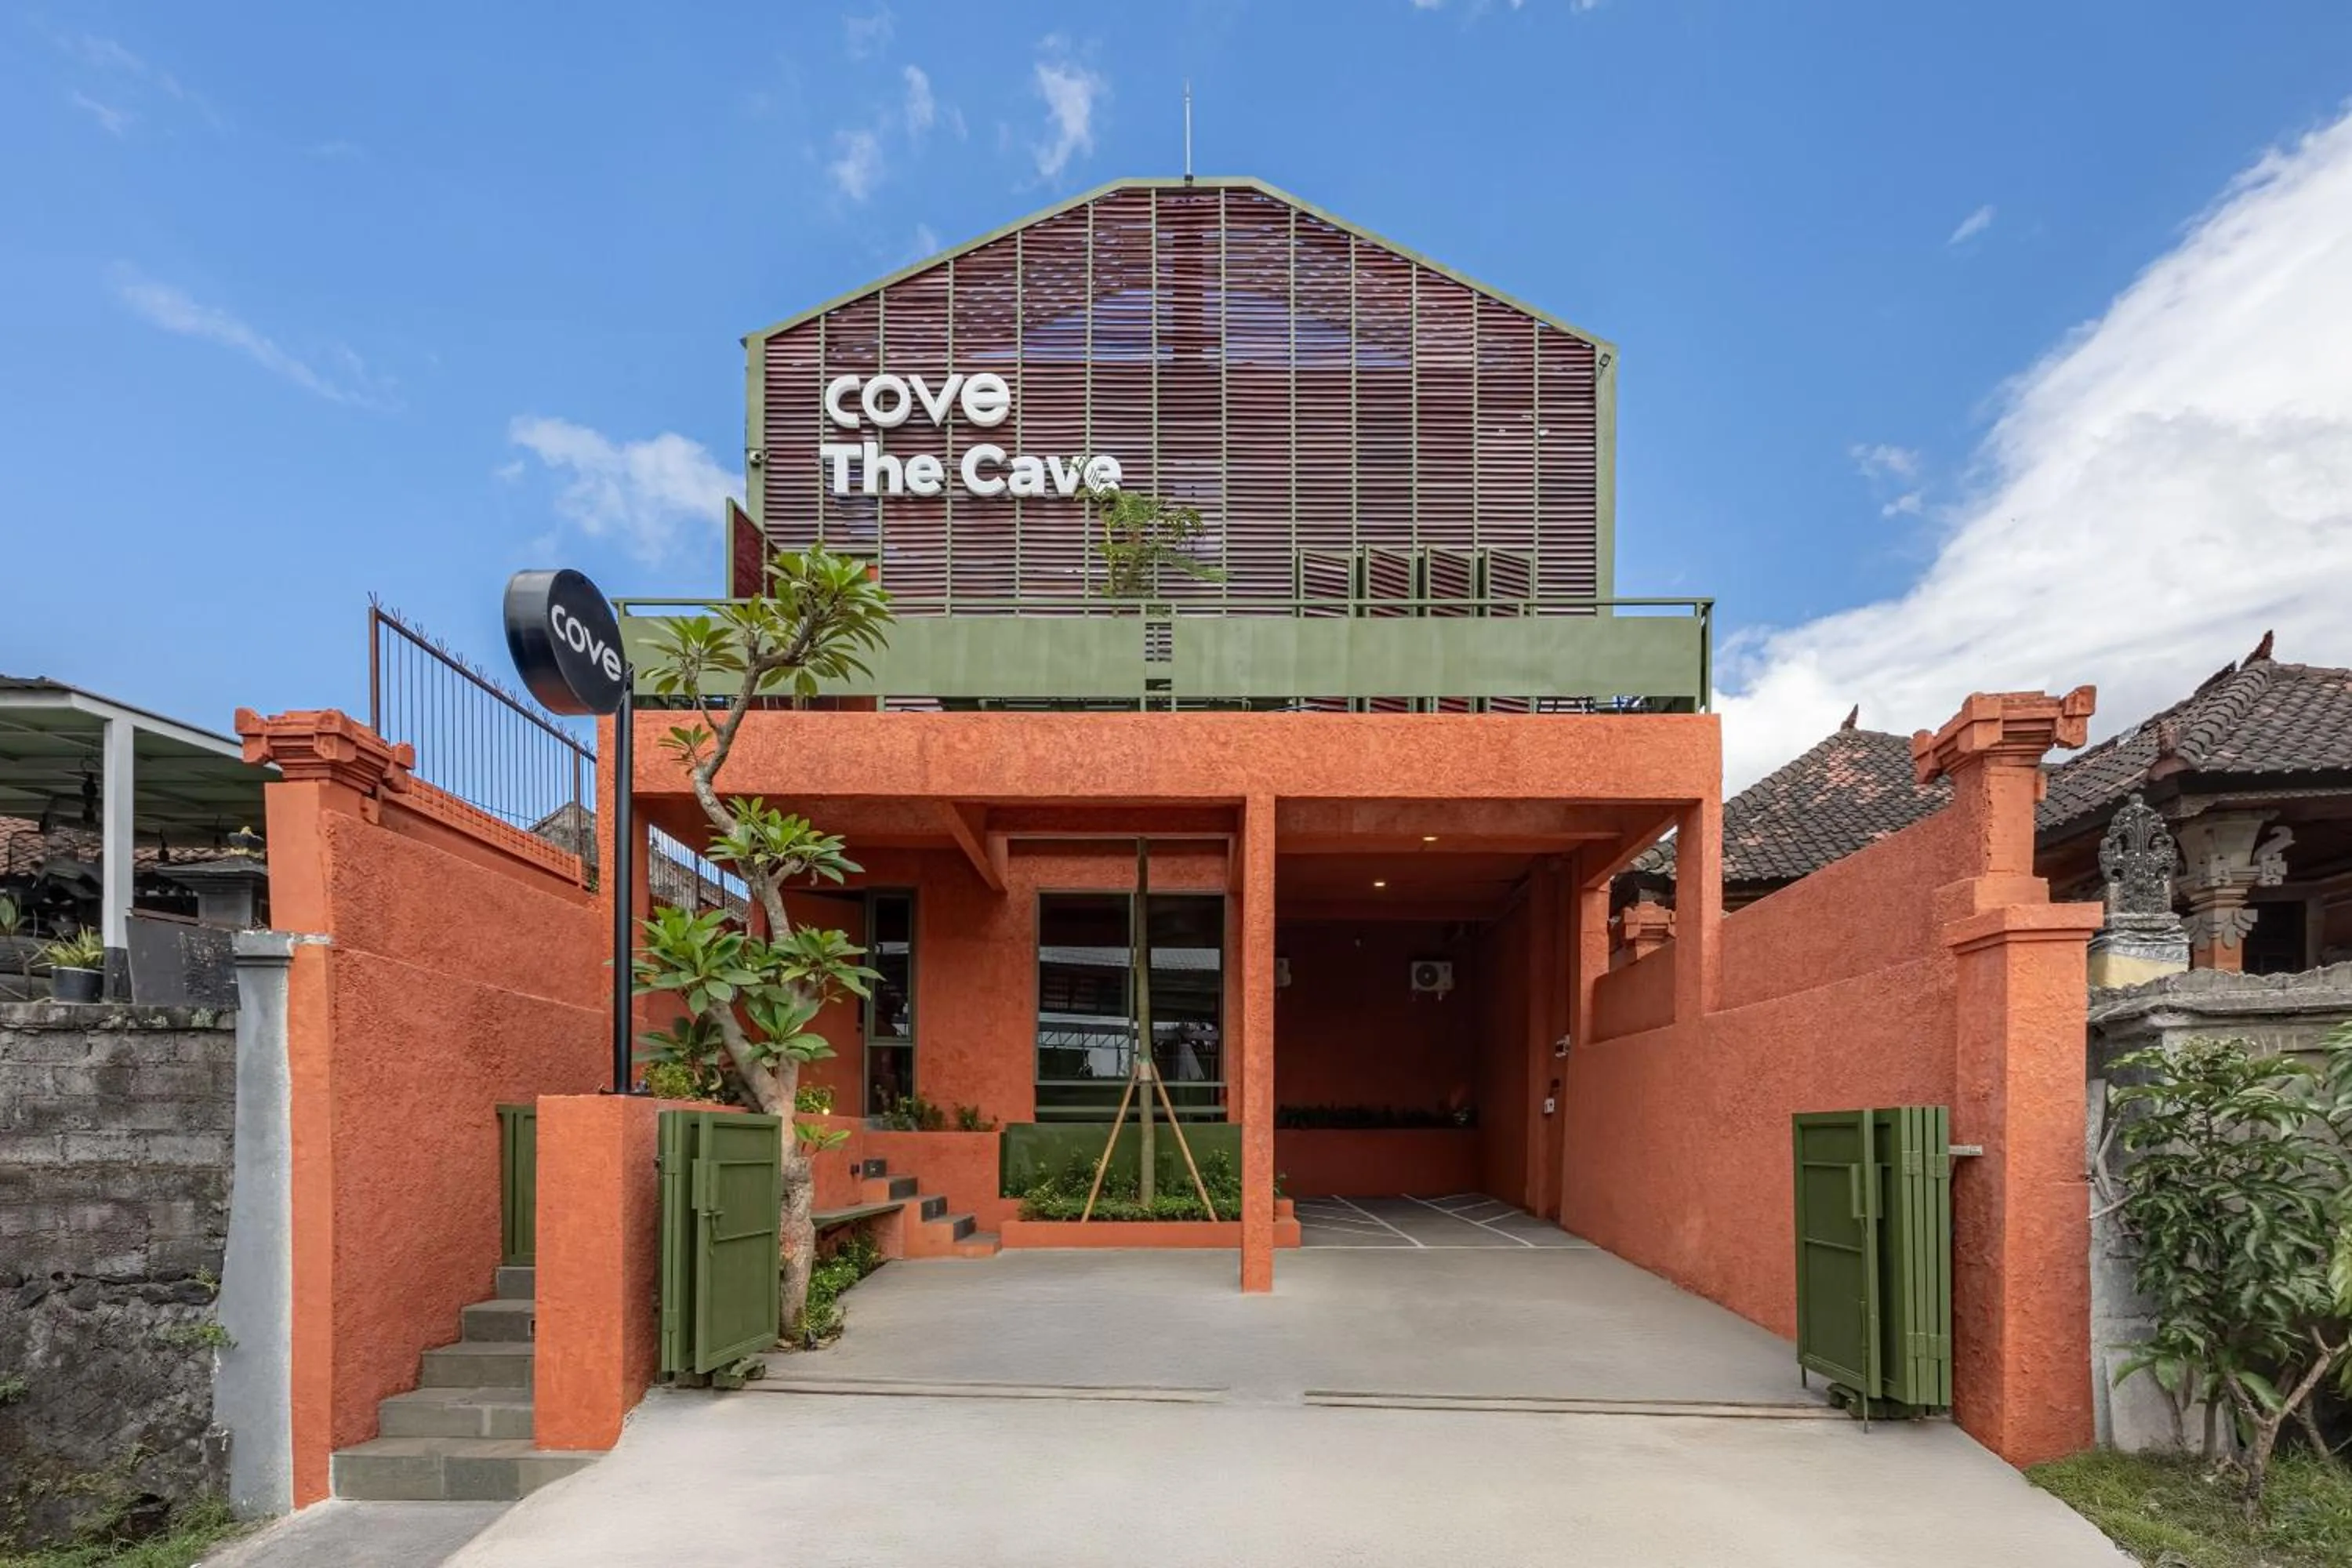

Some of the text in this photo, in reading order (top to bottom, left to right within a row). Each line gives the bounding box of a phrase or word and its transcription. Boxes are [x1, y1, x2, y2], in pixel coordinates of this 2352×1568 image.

[825, 373, 1011, 429] cove
[820, 442, 1122, 497] The Cave
[551, 604, 622, 682] cove
